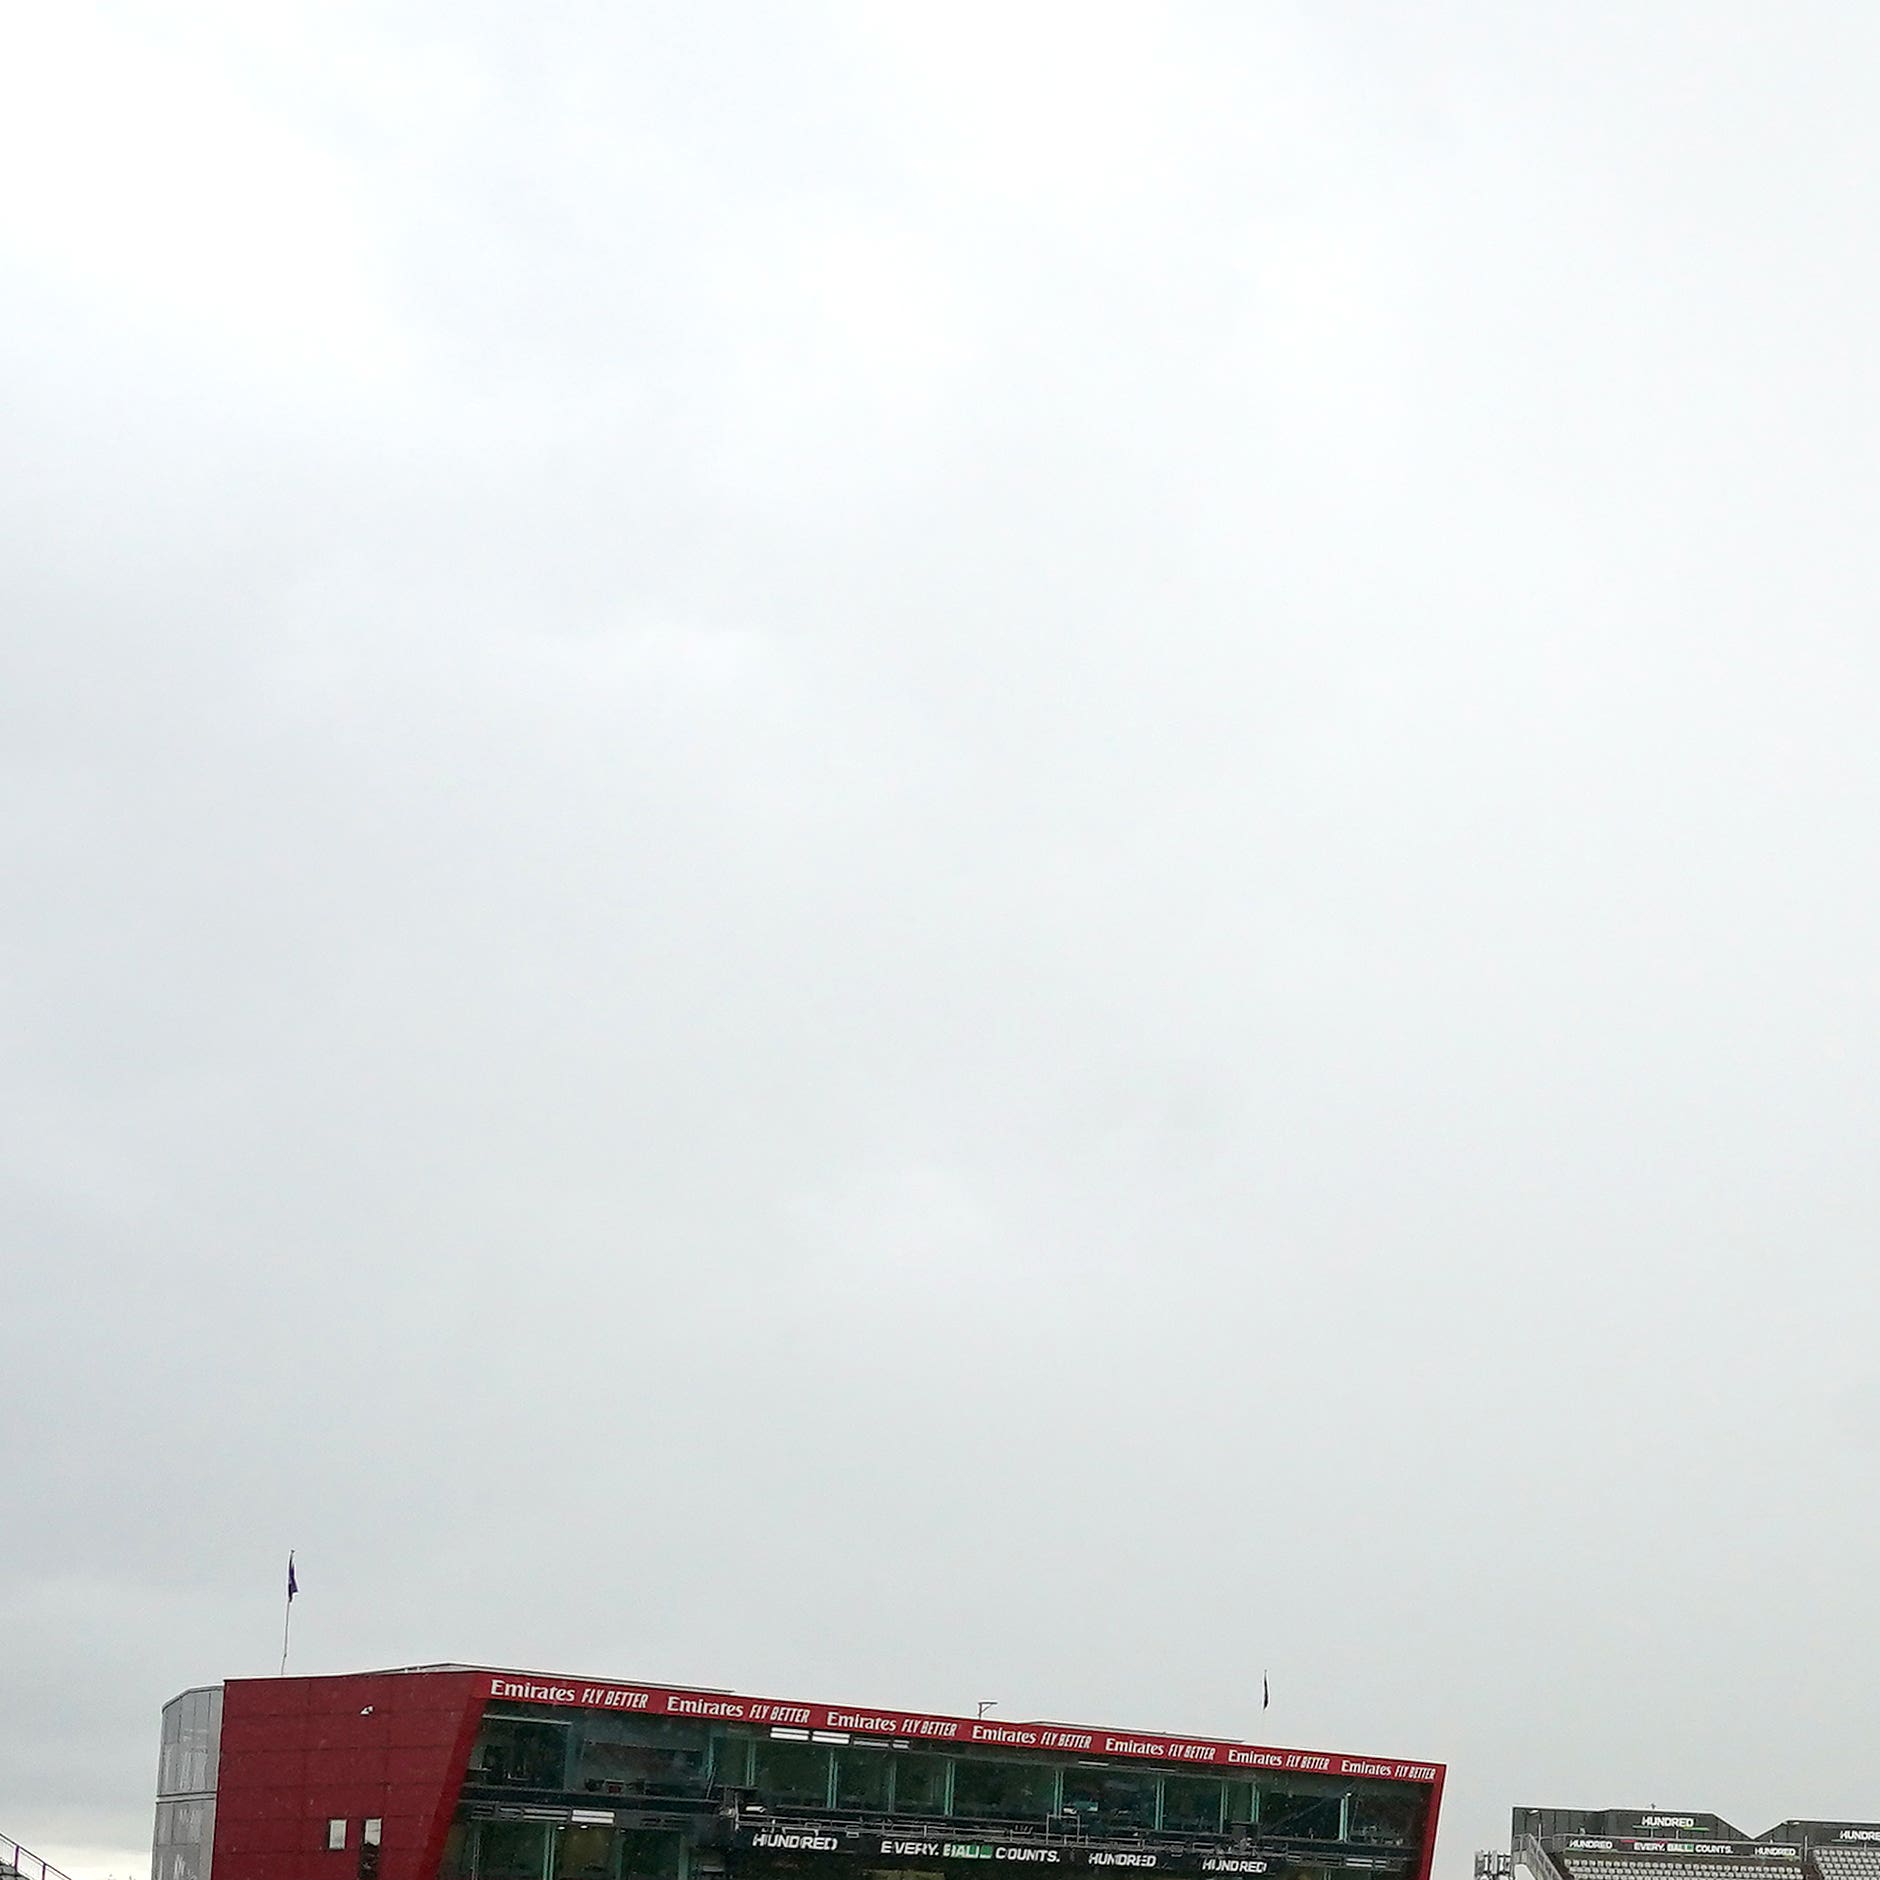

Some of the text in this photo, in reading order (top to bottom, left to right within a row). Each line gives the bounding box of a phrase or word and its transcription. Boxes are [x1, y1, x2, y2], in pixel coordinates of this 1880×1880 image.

[490, 1680, 649, 1709] Emirates FLY BETTER
[667, 1696, 810, 1723] Emirates FLY BETTER
[826, 1712, 957, 1737] Emirates FLY BETTER
[972, 1726, 1092, 1749] Emirates FLY BETTER
[1105, 1738, 1164, 1756] Emirates
[1228, 1750, 1282, 1767] Emirates
[1341, 1760, 1391, 1776] Emirates
[1642, 1815, 1694, 1828] HUNDRED
[1569, 1838, 1612, 1850] HUNDRED
